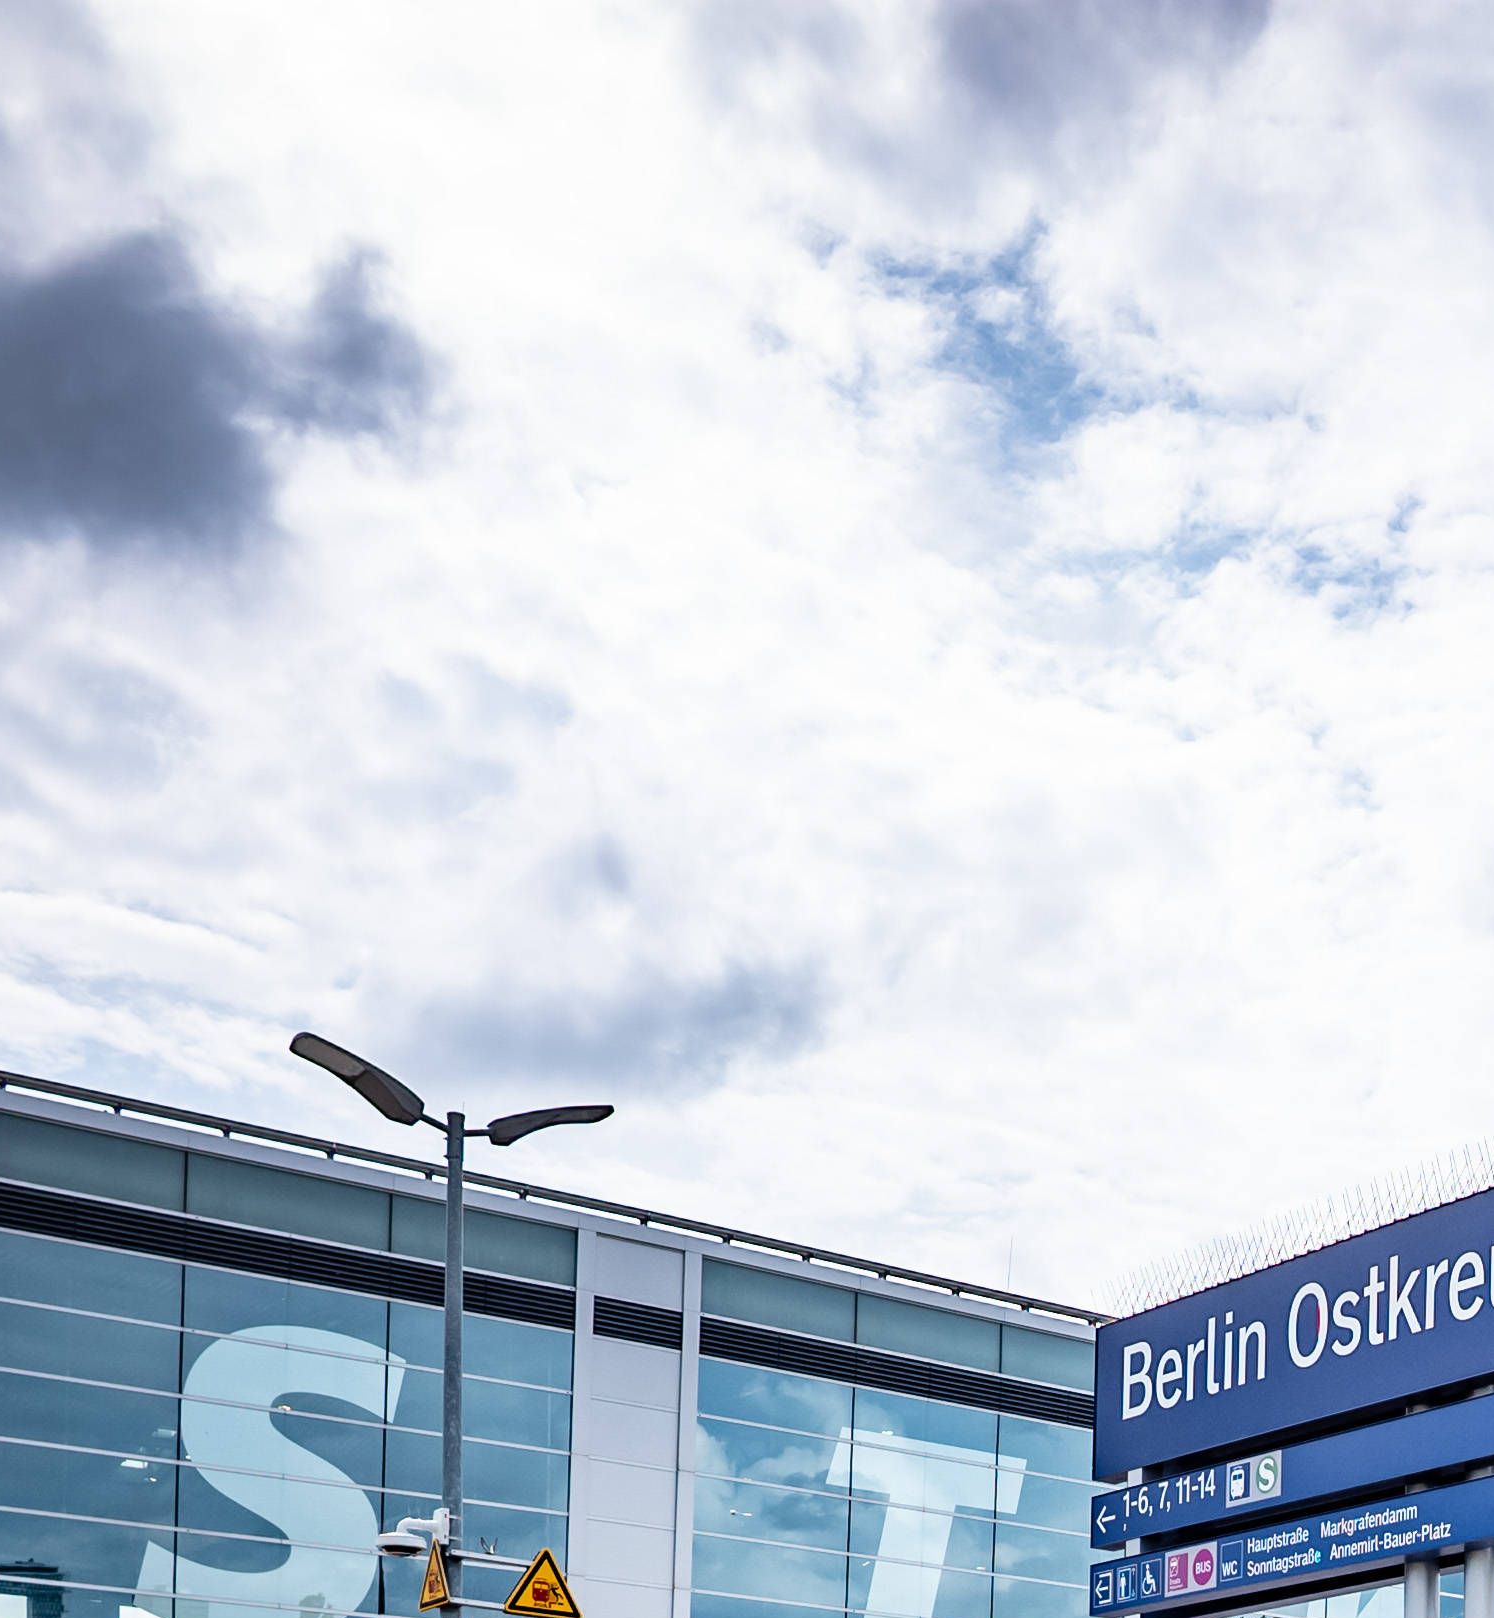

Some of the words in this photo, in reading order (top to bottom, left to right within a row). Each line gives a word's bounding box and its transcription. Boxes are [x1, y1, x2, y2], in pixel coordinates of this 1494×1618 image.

[1122, 1312, 1266, 1420] Berlin
[1176, 1469, 1216, 1504] 11-14
[1195, 1560, 1211, 1574] BUS
[1222, 1561, 1238, 1577] WC
[1247, 1547, 1320, 1577] Sonntagstraße
[1330, 1521, 1451, 1561] Annemirl-Bauer-Platz
[1247, 1527, 1309, 1554] Hauptstraße
[1320, 1505, 1417, 1537] Markgrafendamm
